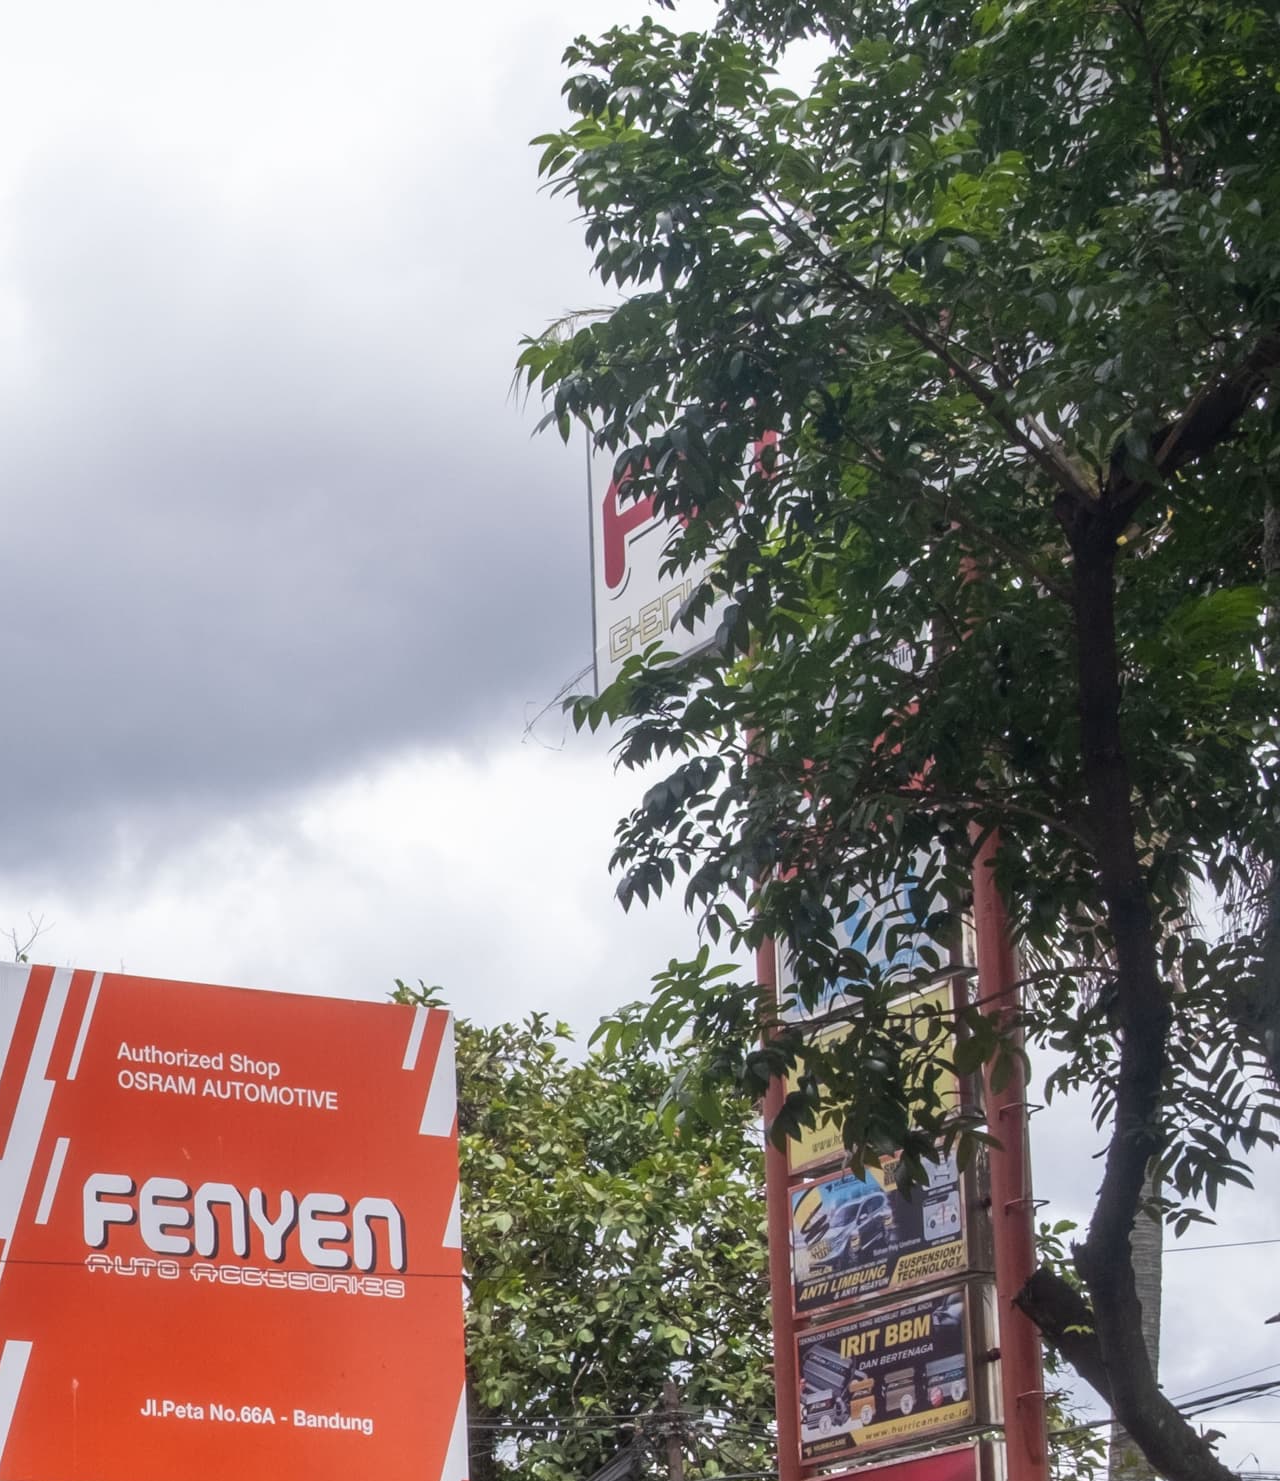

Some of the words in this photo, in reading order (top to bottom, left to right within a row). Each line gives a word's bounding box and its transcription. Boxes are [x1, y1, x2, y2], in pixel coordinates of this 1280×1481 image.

[117, 1042, 223, 1070] Authorized
[230, 1053, 280, 1079] Shop
[118, 1070, 196, 1096] OSRAM
[202, 1082, 338, 1110] AUTOMOTIVE
[82, 1173, 407, 1274] FENYEN
[86, 1254, 180, 1279] AUTO
[800, 1282, 828, 1302] ANTI
[830, 1264, 887, 1293] LIMBUNG
[896, 1255, 962, 1283] TECHNOLOGY
[840, 1328, 881, 1361] IRIT
[884, 1313, 931, 1348] BBM
[858, 1358, 879, 1371] DAN
[879, 1343, 934, 1366] BERTENAGA
[140, 1399, 204, 1420] Jl.Peta
[209, 1403, 276, 1425] No.66A
[293, 1410, 374, 1435] Bandung
